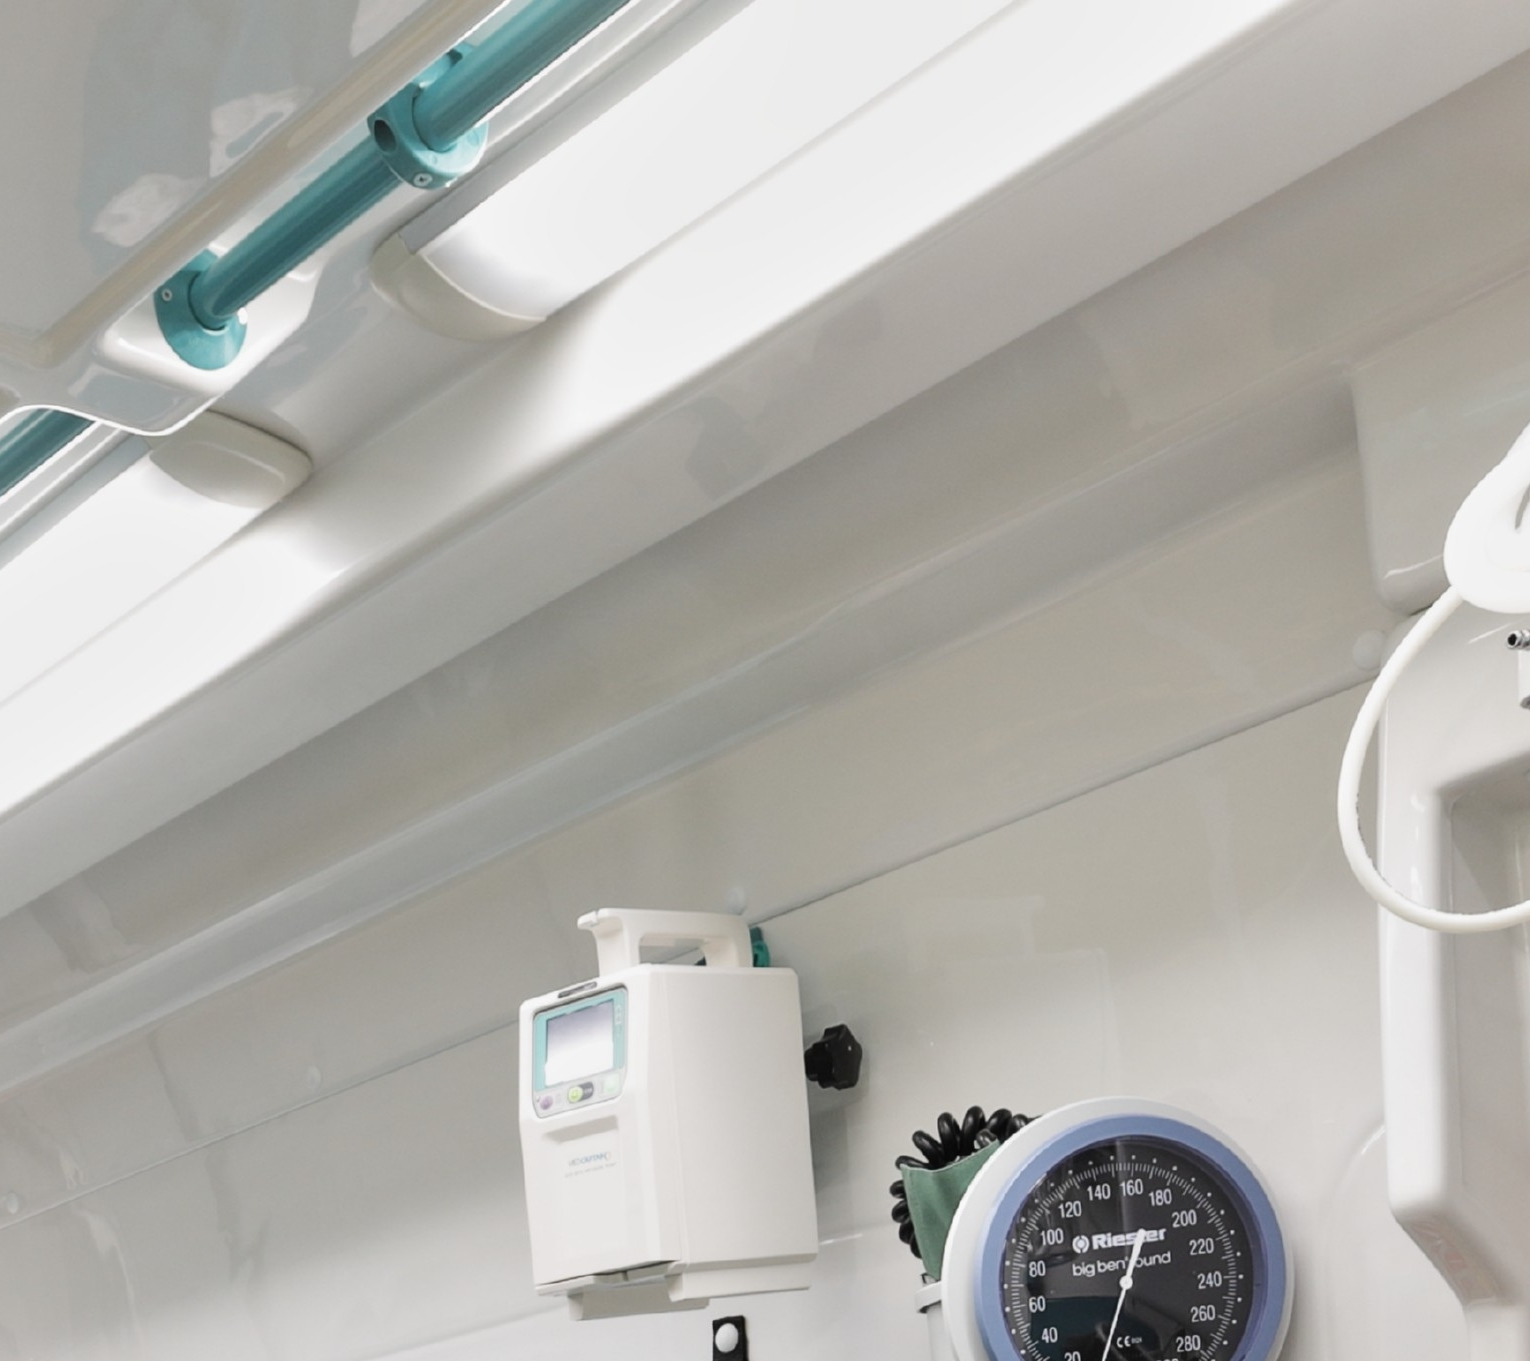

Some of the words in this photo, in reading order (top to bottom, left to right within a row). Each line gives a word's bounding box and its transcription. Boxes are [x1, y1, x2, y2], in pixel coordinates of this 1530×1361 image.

[1087, 1183, 1111, 1201] 140
[1119, 1179, 1144, 1197] 160
[1149, 1188, 1173, 1206] 180
[1058, 1200, 1082, 1218] 120
[1171, 1209, 1198, 1229] 200
[1040, 1227, 1065, 1246] 100
[1092, 1228, 1167, 1250] Rieser
[1189, 1237, 1215, 1256] 220
[1029, 1260, 1046, 1277] 80
[1072, 1262, 1096, 1277] big
[1133, 1251, 1171, 1268] ound
[1197, 1271, 1223, 1289] 240
[1029, 1296, 1046, 1313] 60
[1191, 1304, 1216, 1322] 260
[1041, 1326, 1059, 1344] 40
[1176, 1335, 1202, 1353] 280
